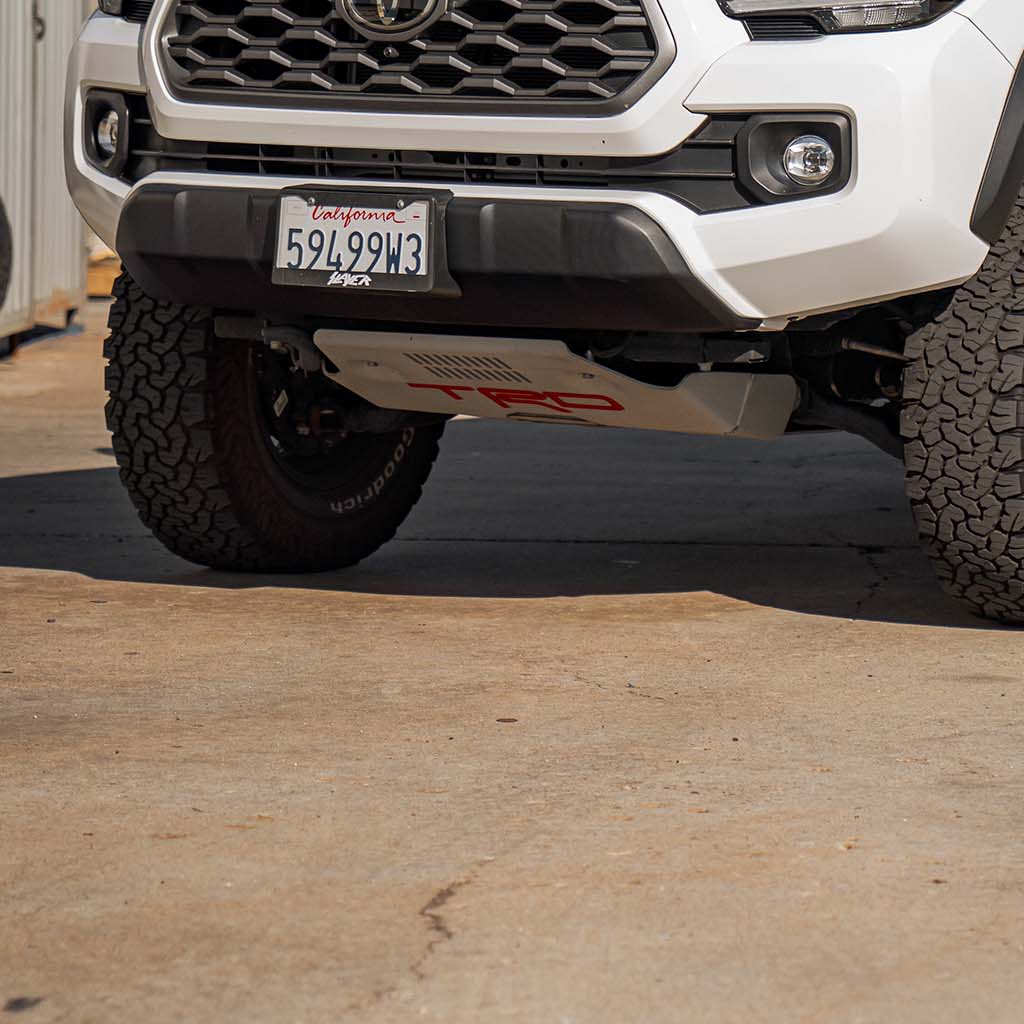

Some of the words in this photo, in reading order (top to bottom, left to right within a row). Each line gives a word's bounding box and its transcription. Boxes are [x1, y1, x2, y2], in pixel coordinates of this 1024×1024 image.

[312, 205, 405, 227] California
[286, 228, 423, 275] 59499W3
[327, 271, 372, 286] SLAYER
[405, 382, 625, 413] TRD
